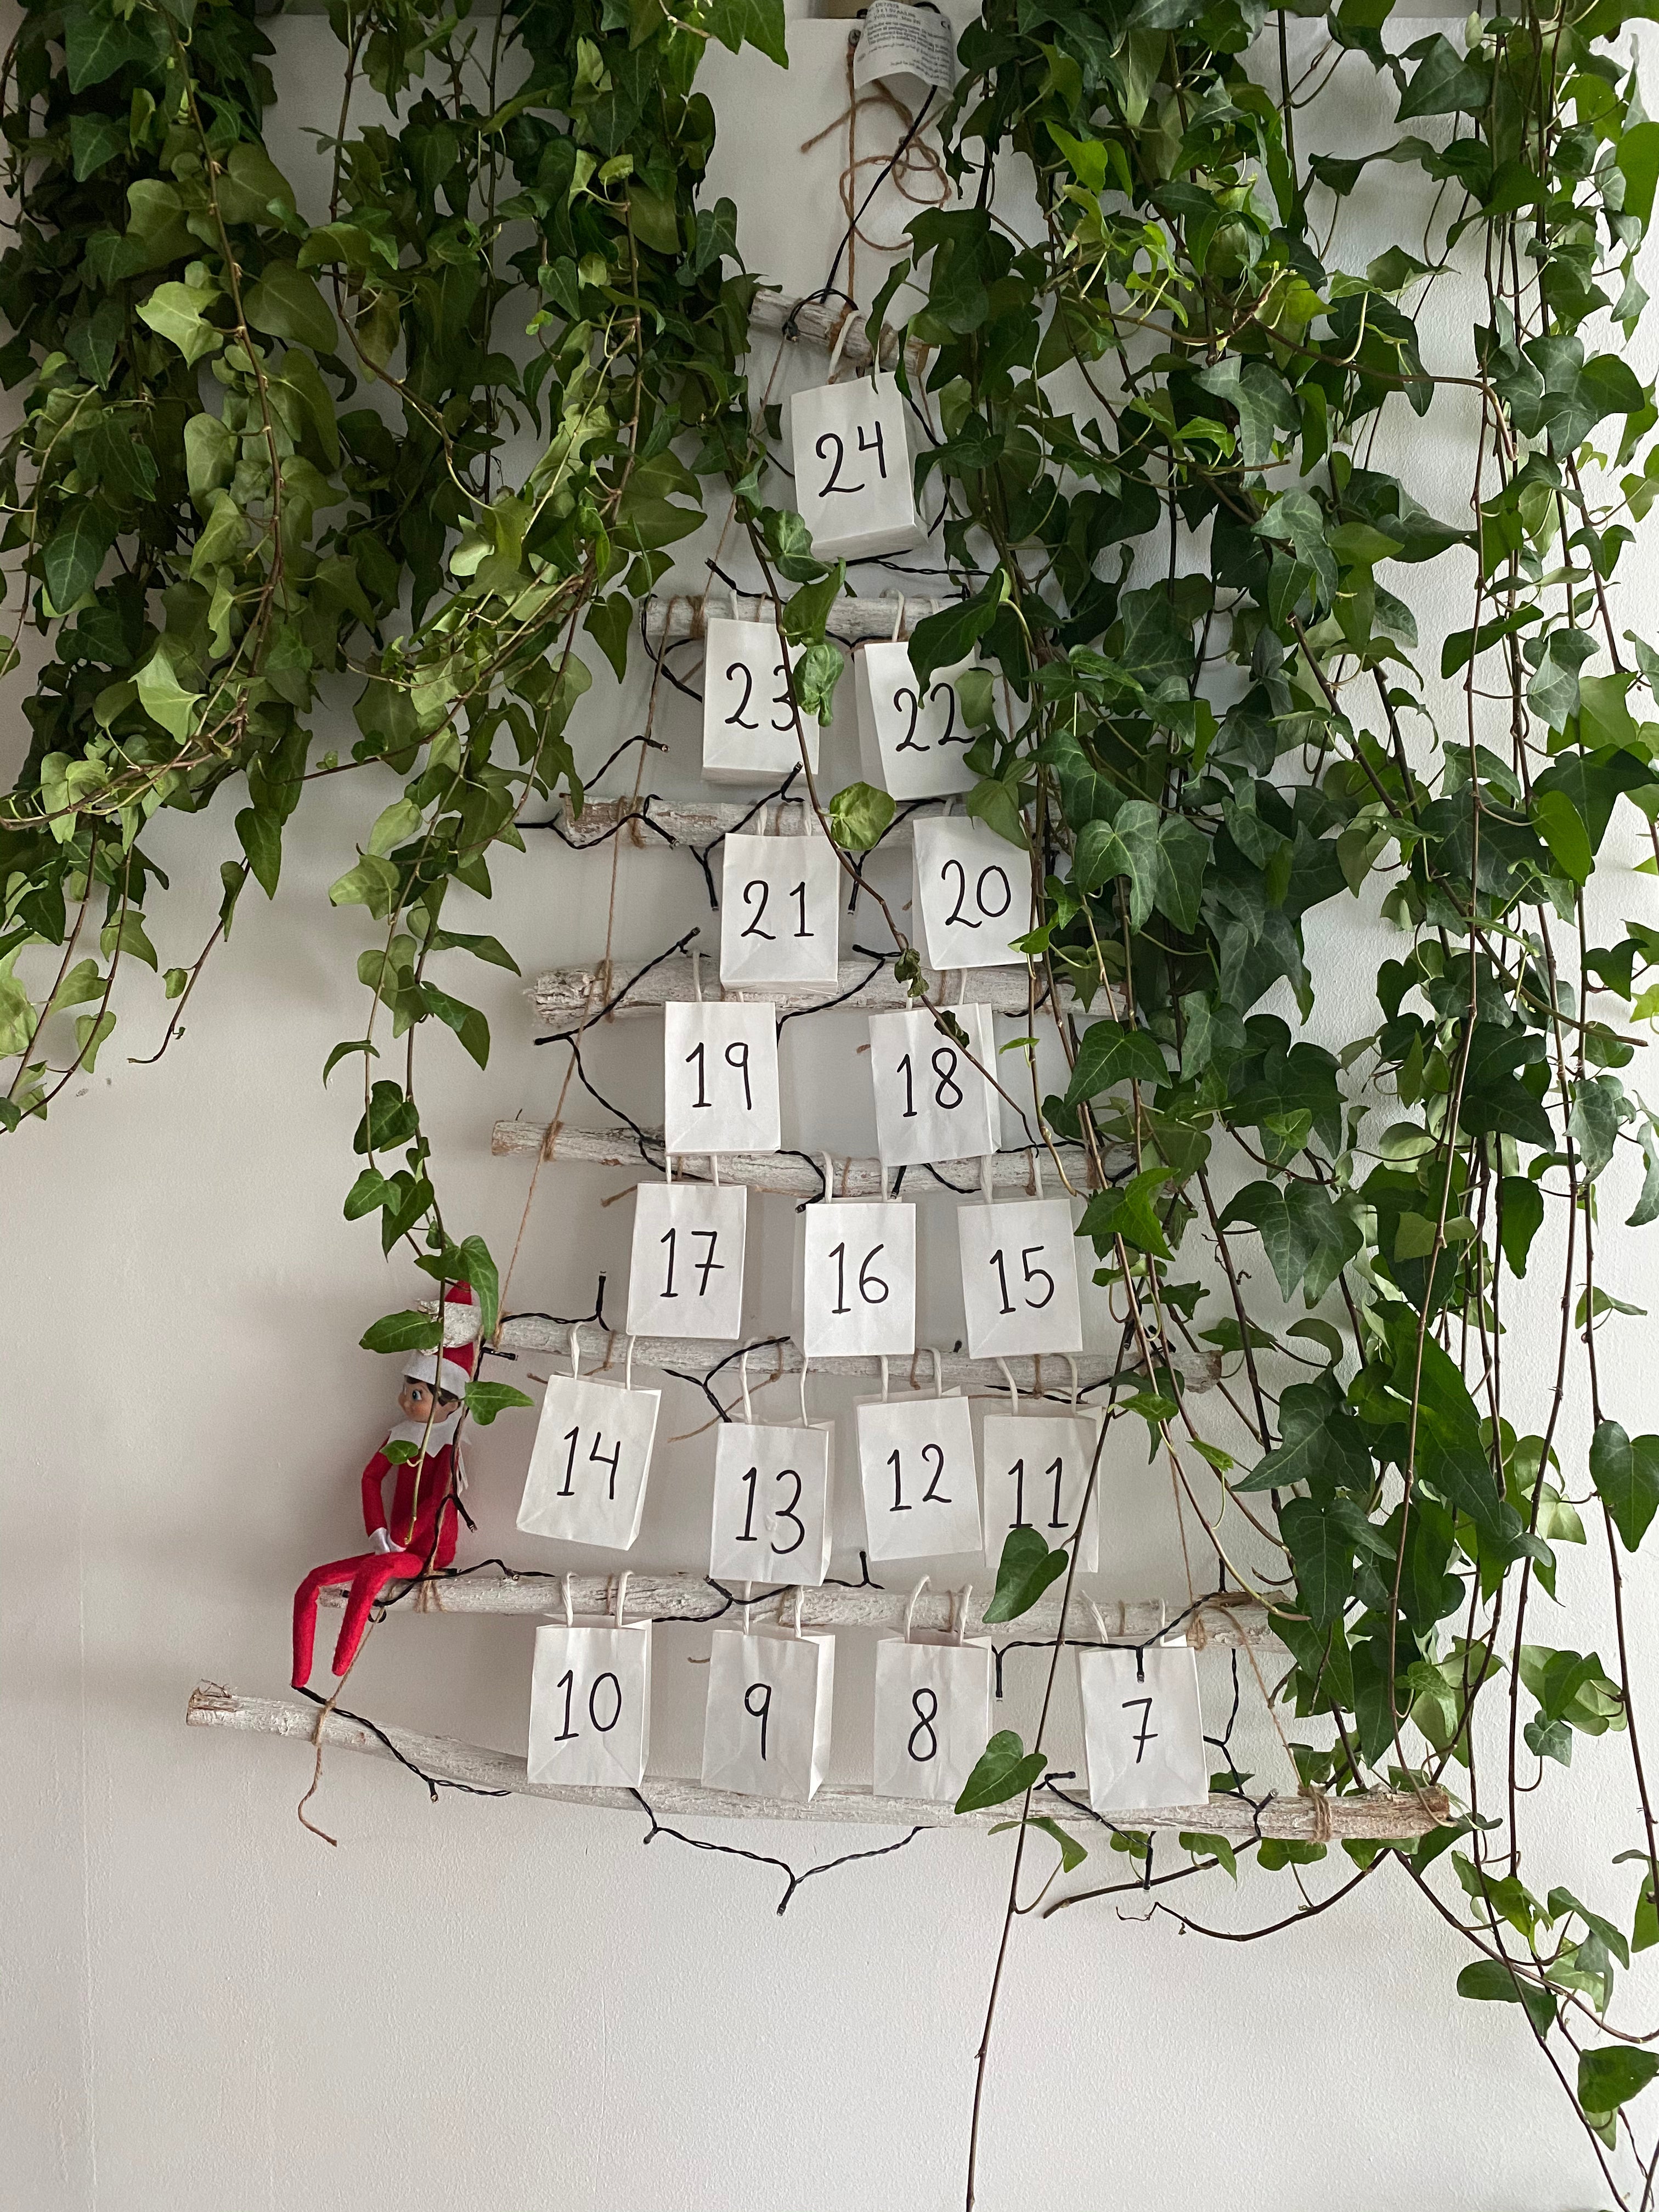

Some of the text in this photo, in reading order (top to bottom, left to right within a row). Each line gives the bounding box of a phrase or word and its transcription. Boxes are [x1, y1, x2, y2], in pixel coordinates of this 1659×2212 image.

[816, 421, 887, 497] 24
[725, 663, 797, 731] 23
[894, 682, 976, 752] 22
[741, 881, 814, 940] 21
[941, 860, 1011, 928] 20
[686, 1042, 751, 1110] 19
[897, 1048, 963, 1117] 18
[660, 1228, 724, 1297] 17
[829, 1243, 888, 1314] 16
[990, 1246, 1054, 1314] 15
[557, 1426, 620, 1499] 14
[888, 1444, 951, 1511] 12
[1008, 1457, 1069, 1528] 11
[736, 1467, 804, 1554] 13
[555, 1670, 621, 1741] 10
[744, 1684, 771, 1760] 9
[908, 1688, 937, 1762] 8
[1122, 1698, 1158, 1763] 7
